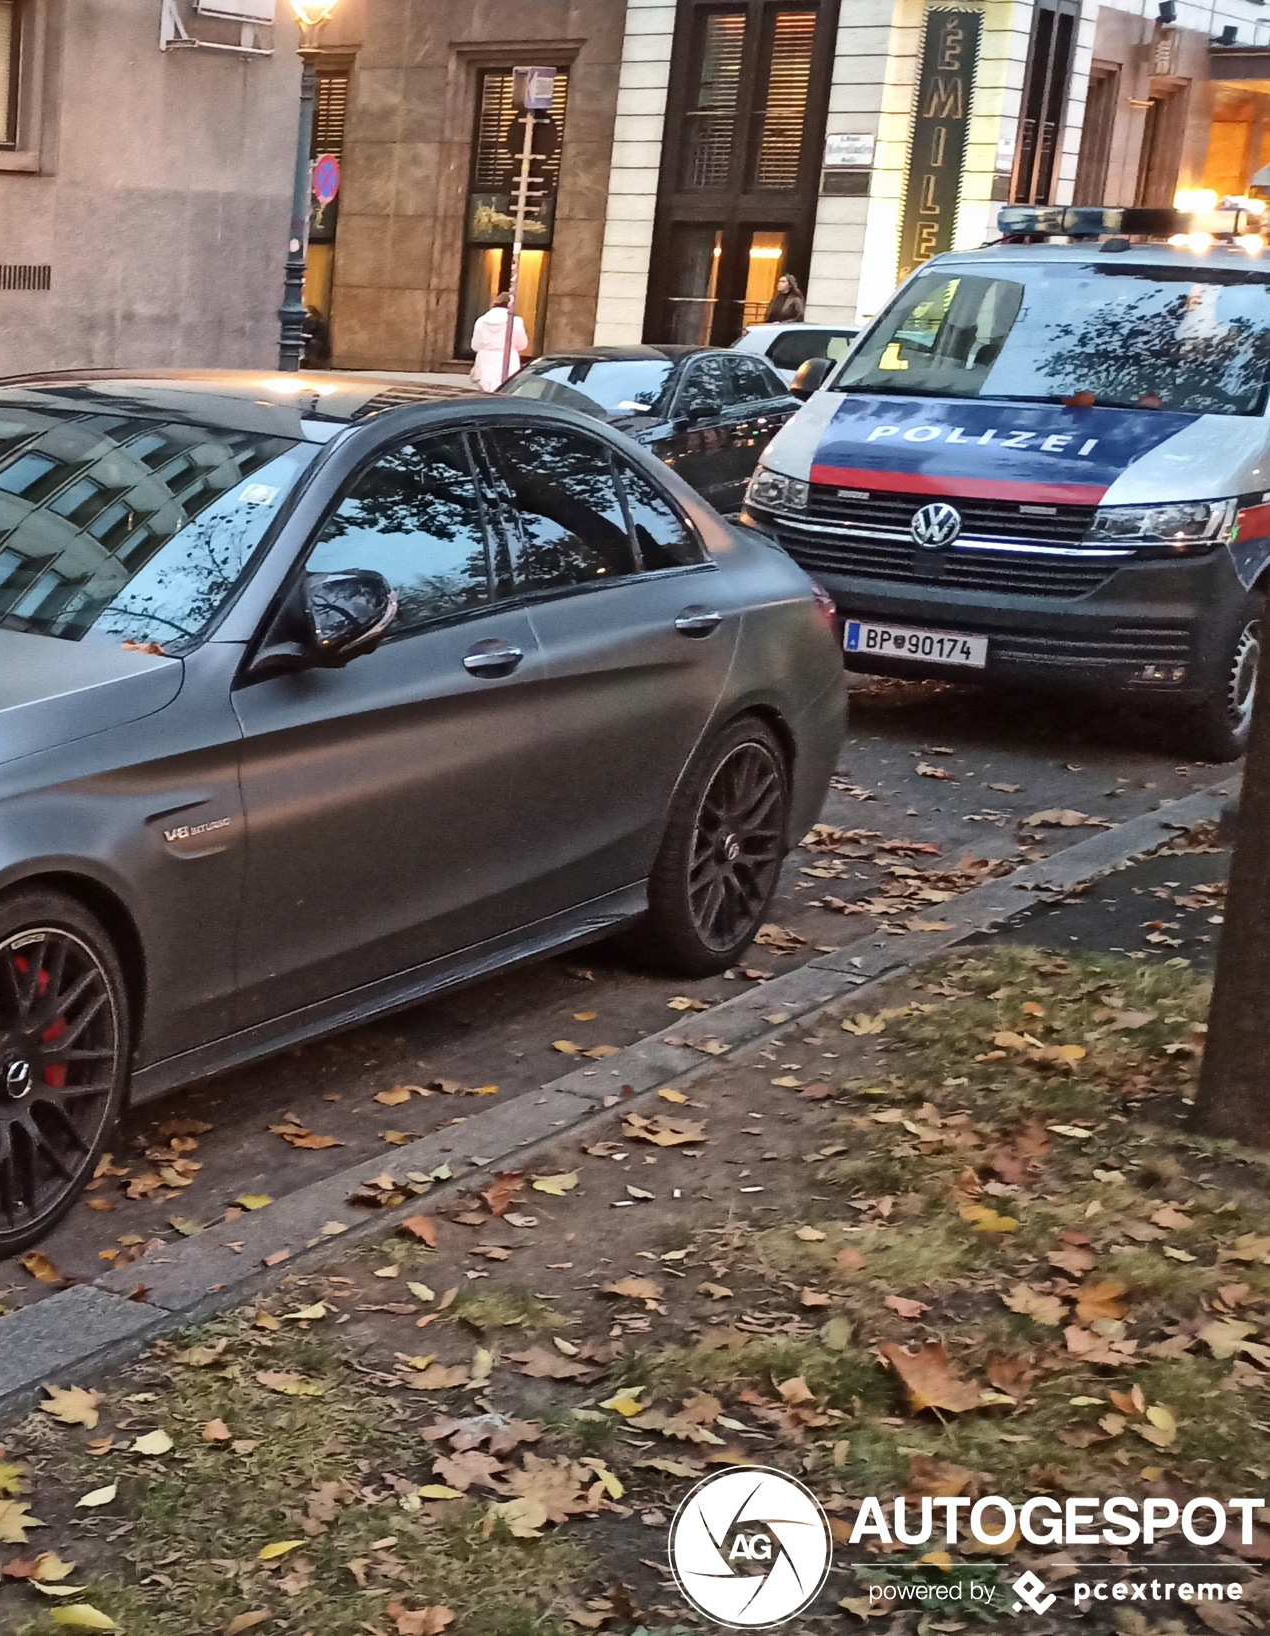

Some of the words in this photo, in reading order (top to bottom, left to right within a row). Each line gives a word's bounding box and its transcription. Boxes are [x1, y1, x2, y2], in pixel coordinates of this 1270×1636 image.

[912, 16, 963, 262] ÉMILE
[867, 425, 1098, 455] POLIZEI
[866, 629, 891, 650] BP
[907, 634, 971, 660] 90174
[163, 825, 190, 842] V8
